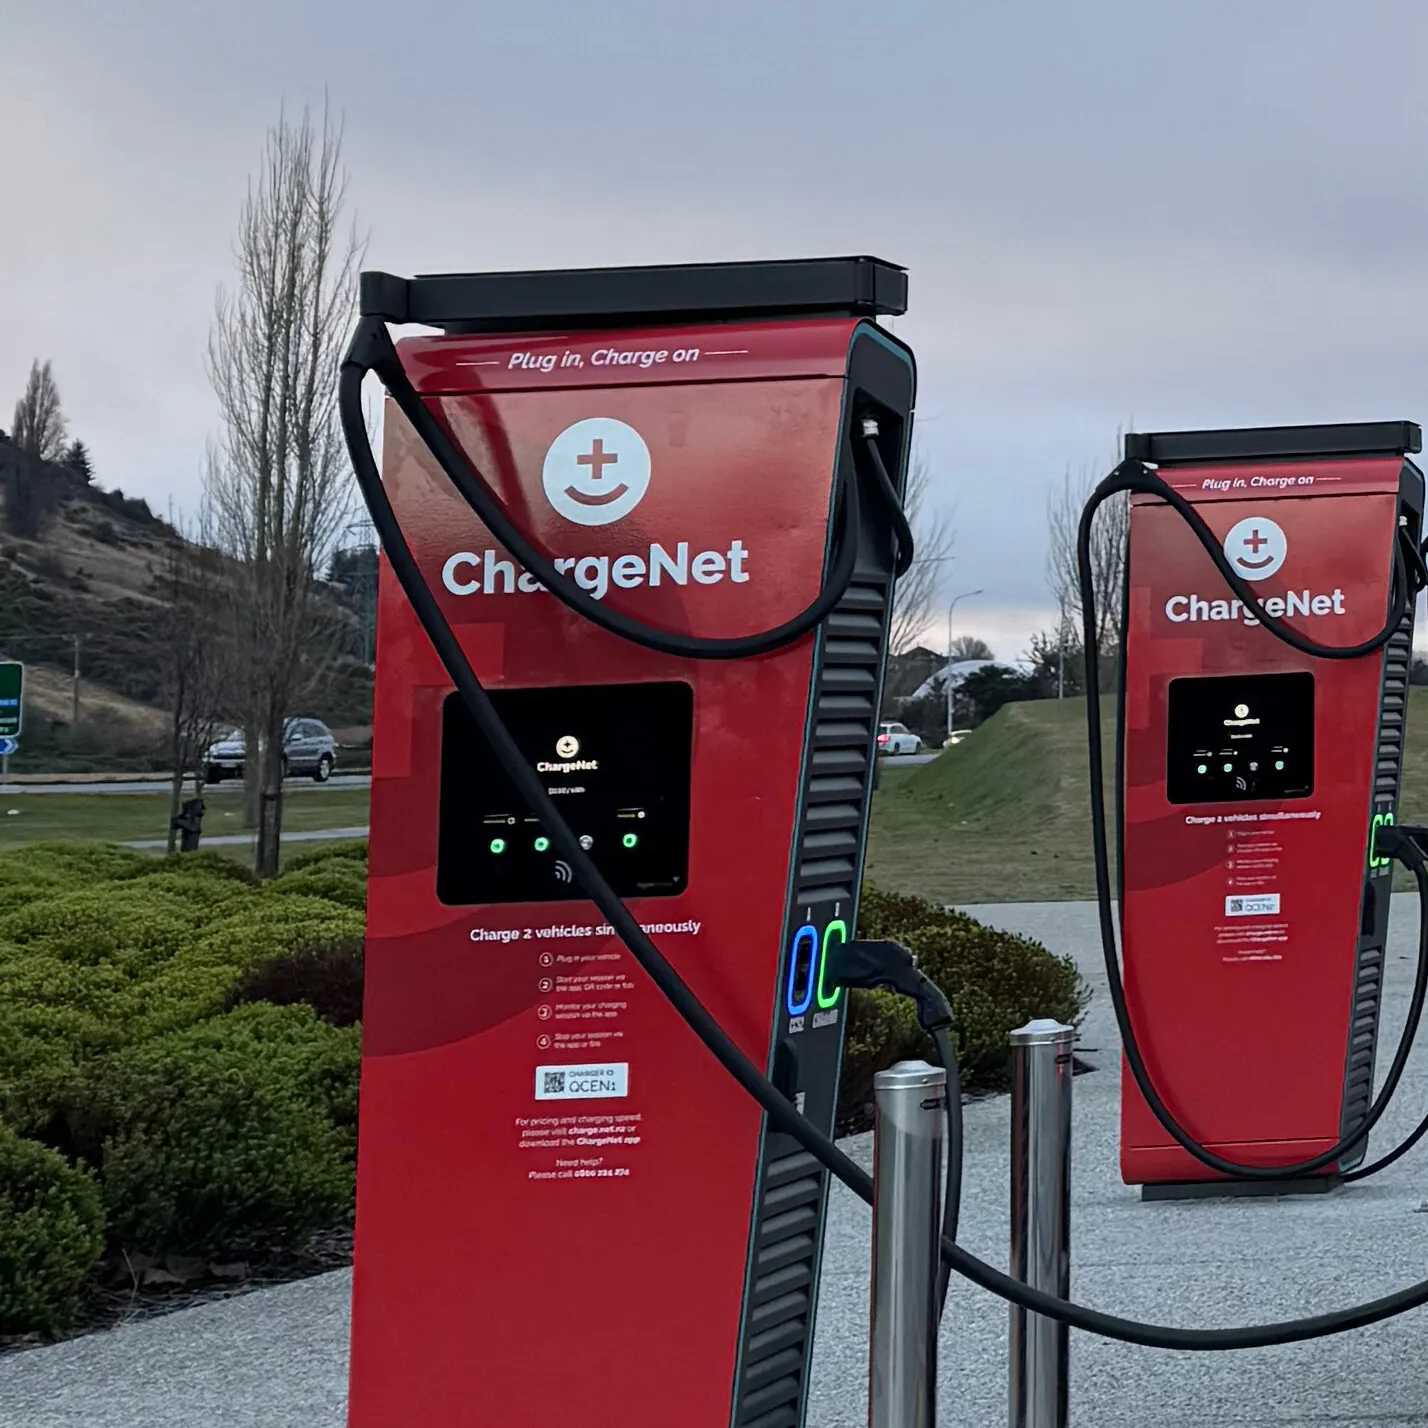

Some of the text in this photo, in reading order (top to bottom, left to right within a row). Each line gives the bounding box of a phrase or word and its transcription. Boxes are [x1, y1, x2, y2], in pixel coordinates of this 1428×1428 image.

[508, 347, 700, 373] Plug in, Charge on
[1202, 478, 1231, 491] Plug
[1250, 476, 1295, 489] Charge
[1297, 475, 1315, 485] on
[469, 919, 702, 944] Charge 2 vehicles simaneously
